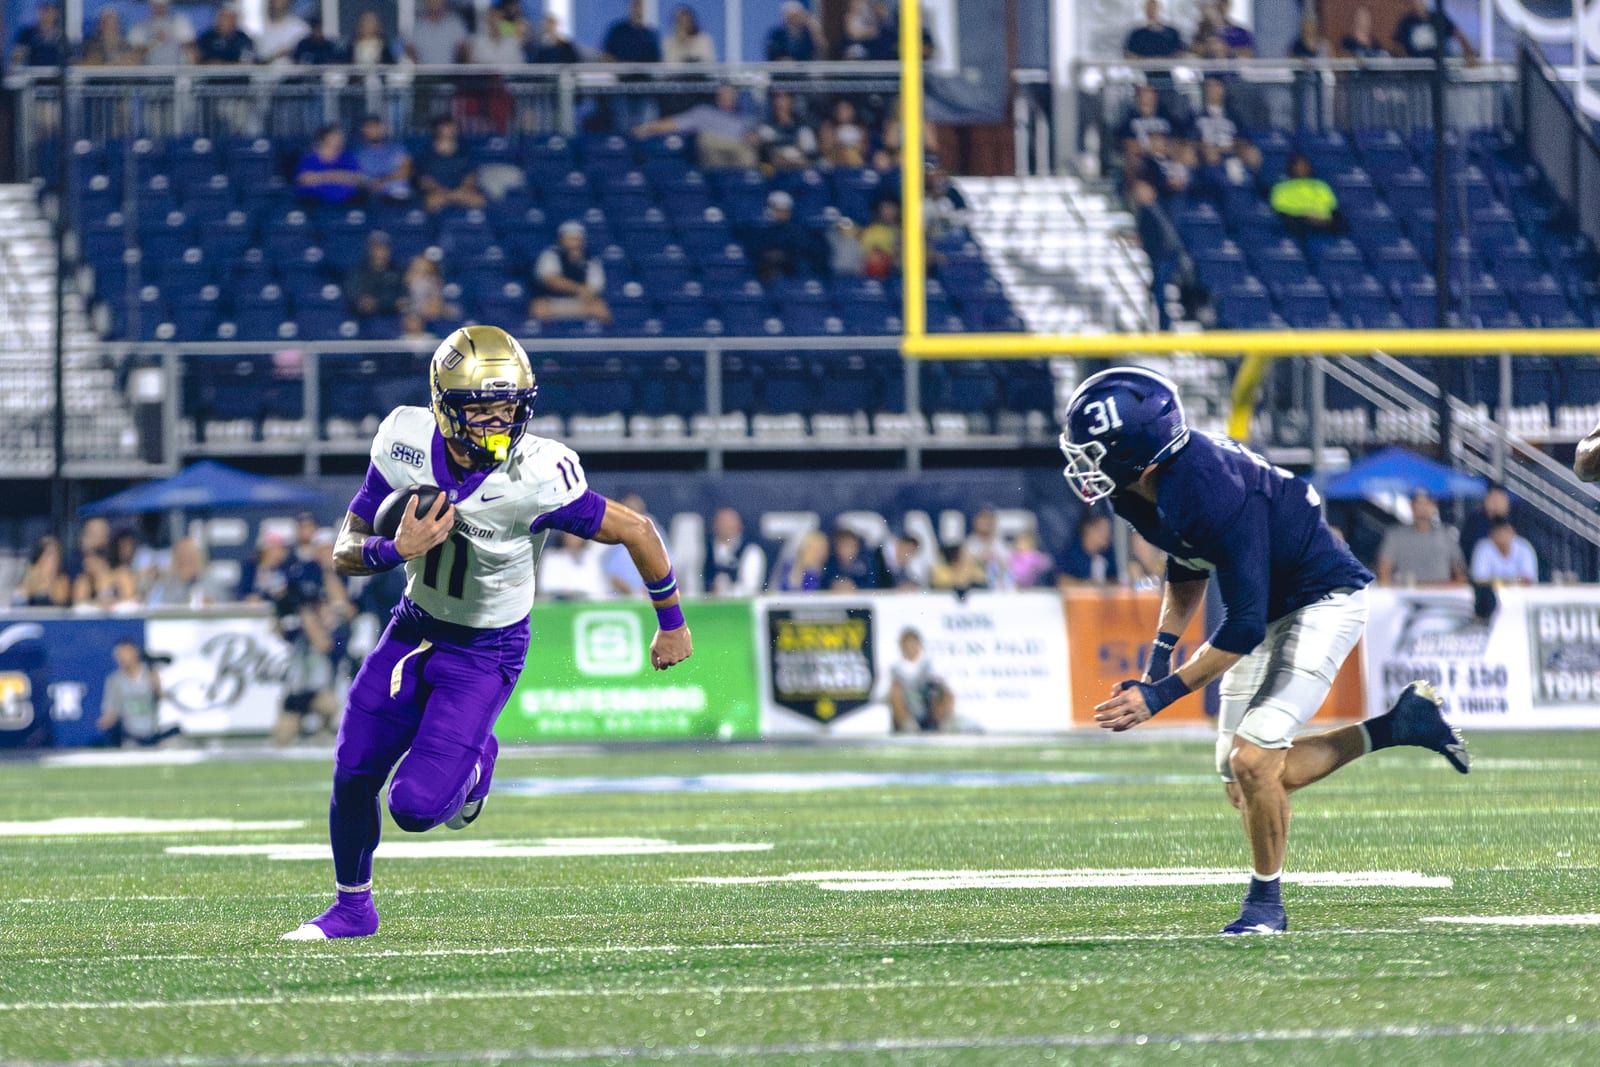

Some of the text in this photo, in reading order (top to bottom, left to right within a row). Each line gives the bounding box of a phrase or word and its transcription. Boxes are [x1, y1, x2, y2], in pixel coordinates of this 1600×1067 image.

[1083, 396, 1123, 435] 31
[391, 442, 425, 468] SBC
[556, 456, 579, 491] 11
[423, 532, 468, 599] 11
[1540, 606, 1600, 641] BUIL
